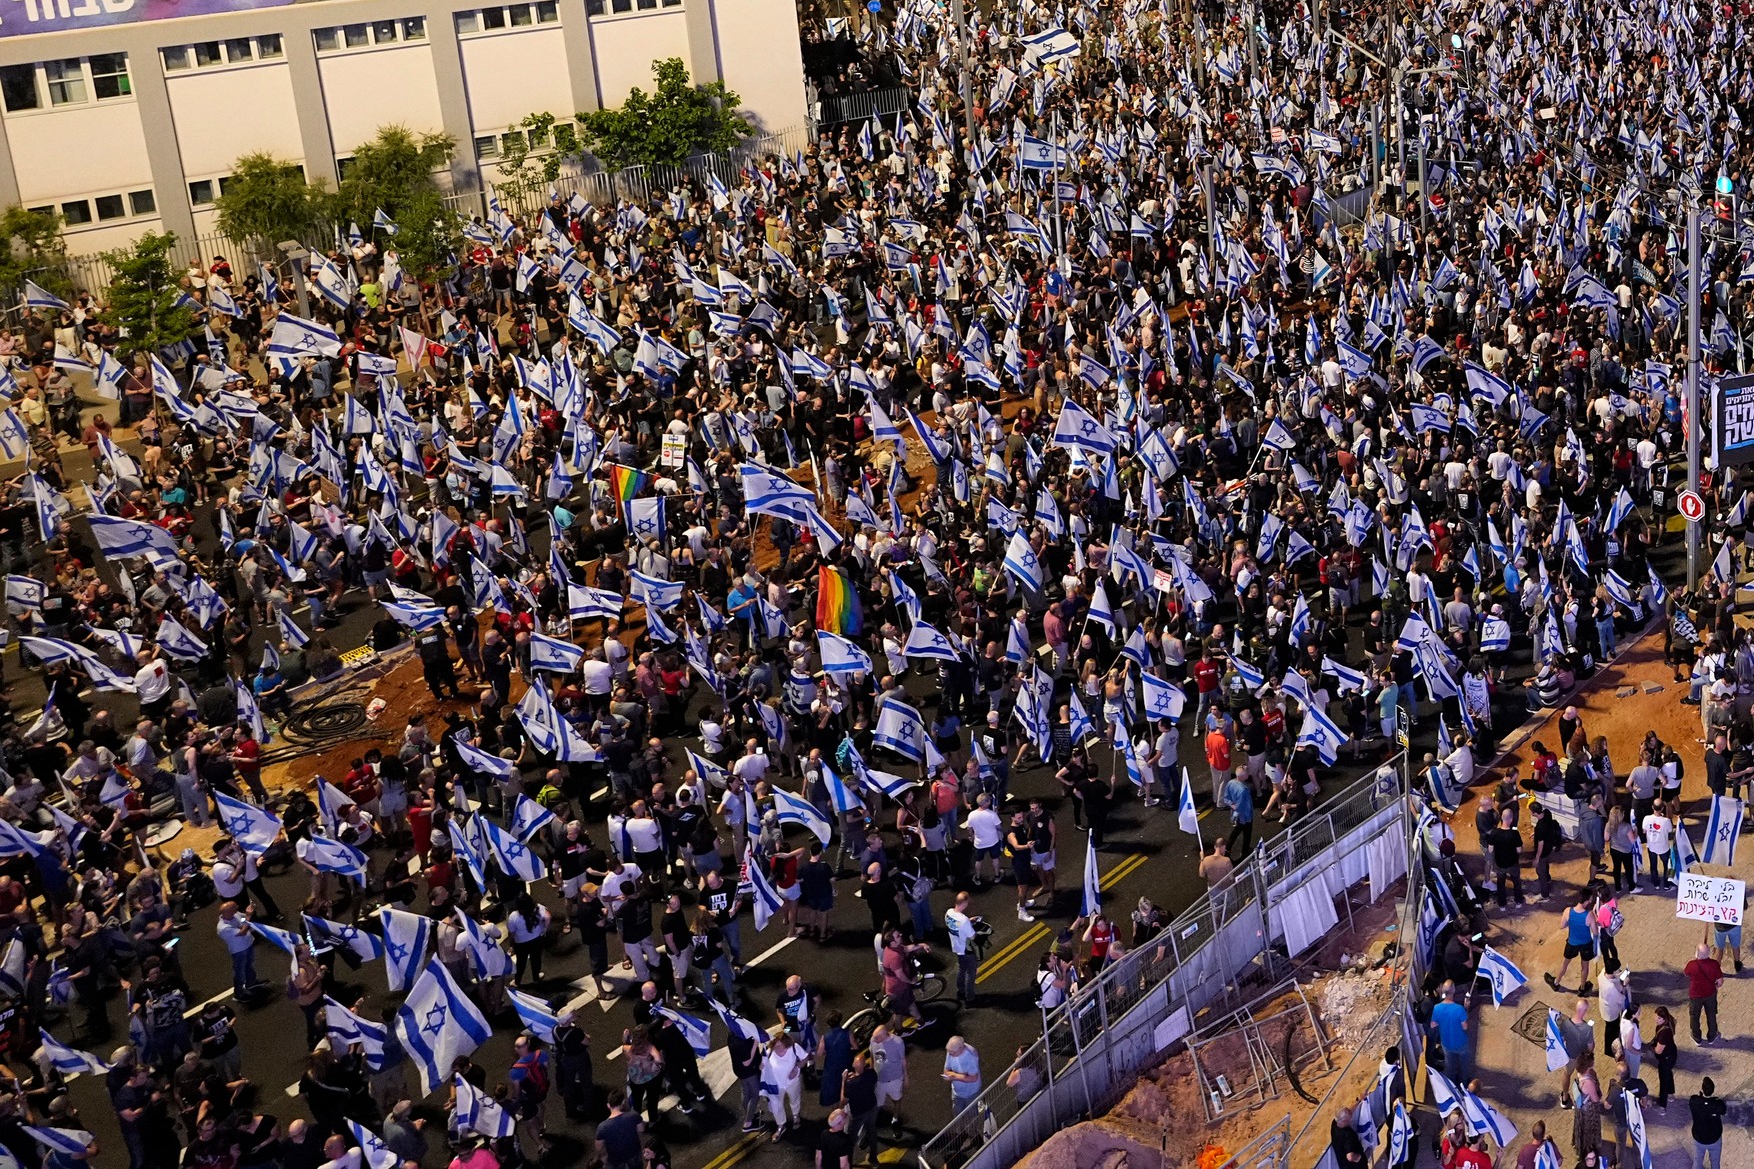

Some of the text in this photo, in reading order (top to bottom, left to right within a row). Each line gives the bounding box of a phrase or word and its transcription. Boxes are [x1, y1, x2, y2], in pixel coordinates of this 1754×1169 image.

[1687, 878, 1735, 892] בלי ליבה
[1684, 889, 1733, 903] ובלי שרות
[1678, 901, 1738, 921] קץ הציונות
